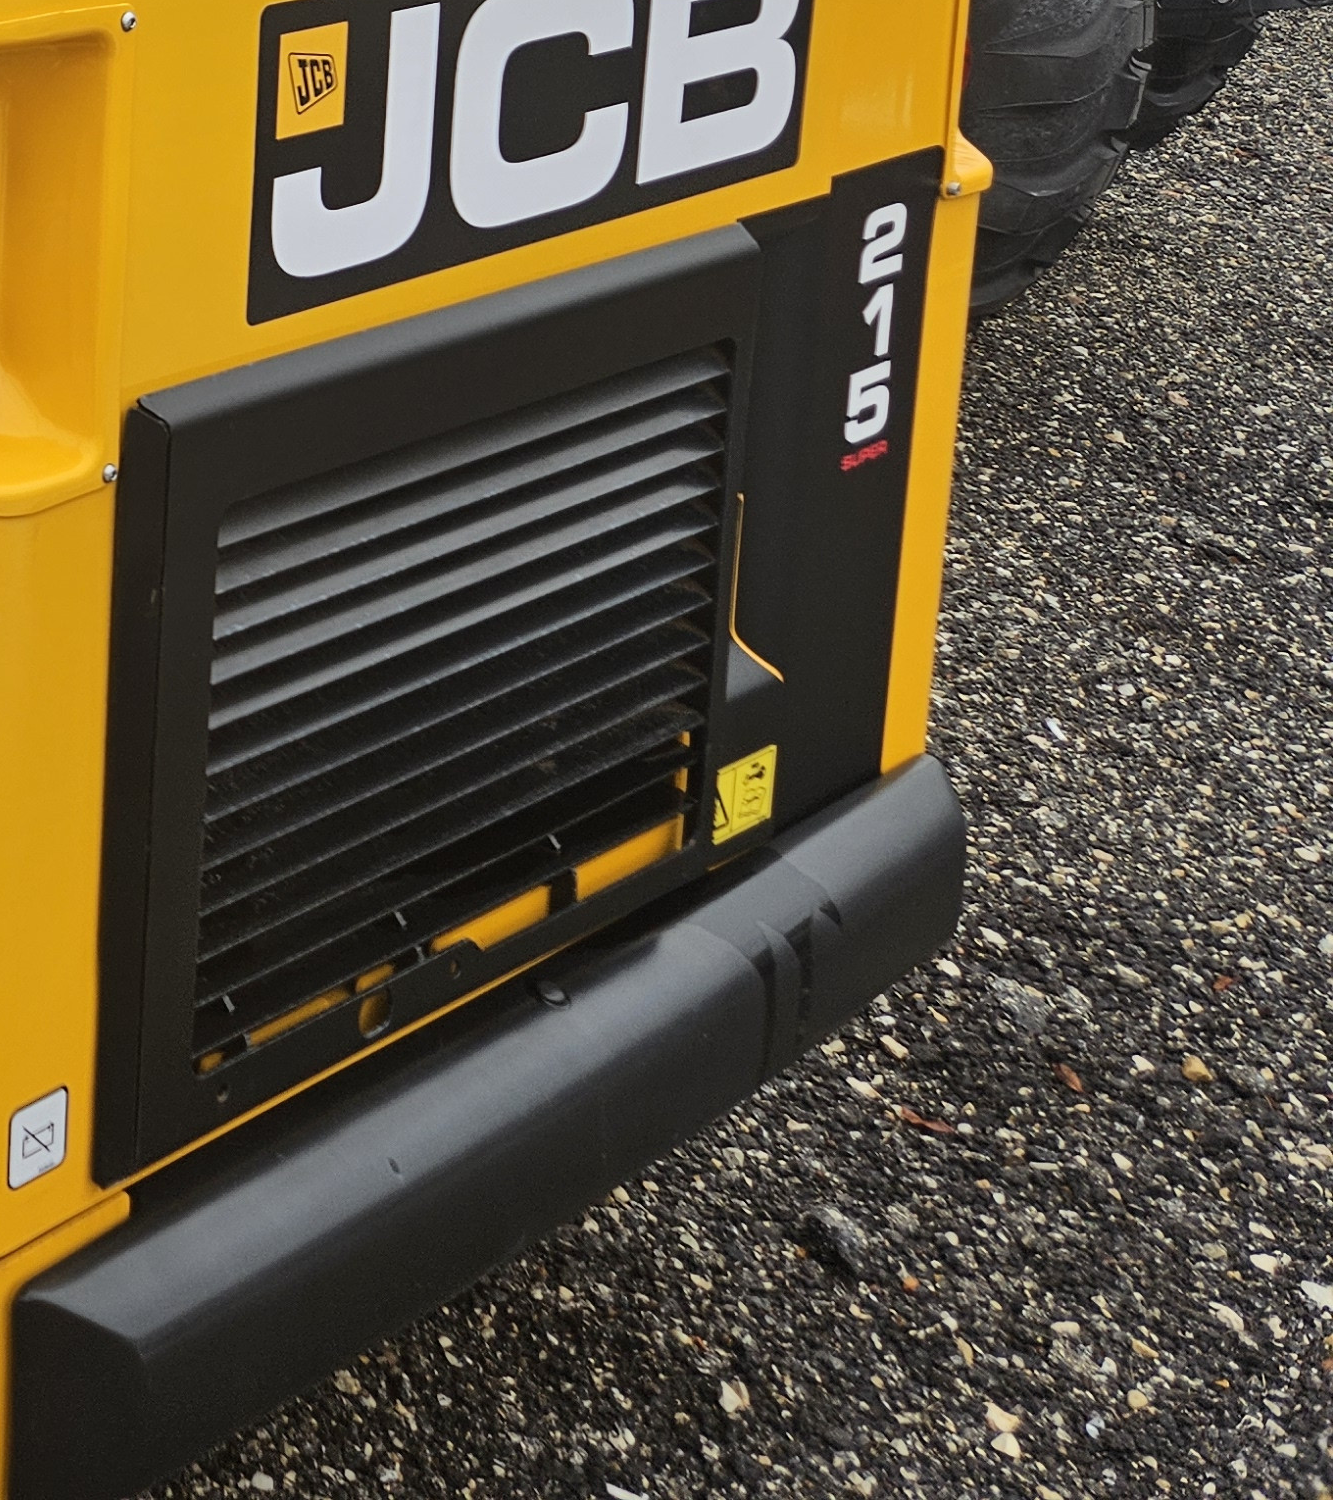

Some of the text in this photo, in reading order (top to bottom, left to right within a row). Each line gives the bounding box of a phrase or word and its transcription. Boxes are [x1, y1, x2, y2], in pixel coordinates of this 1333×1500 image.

[295, 54, 338, 109] JCB
[844, 202, 908, 444] 215
[839, 440, 888, 472] SUPER
